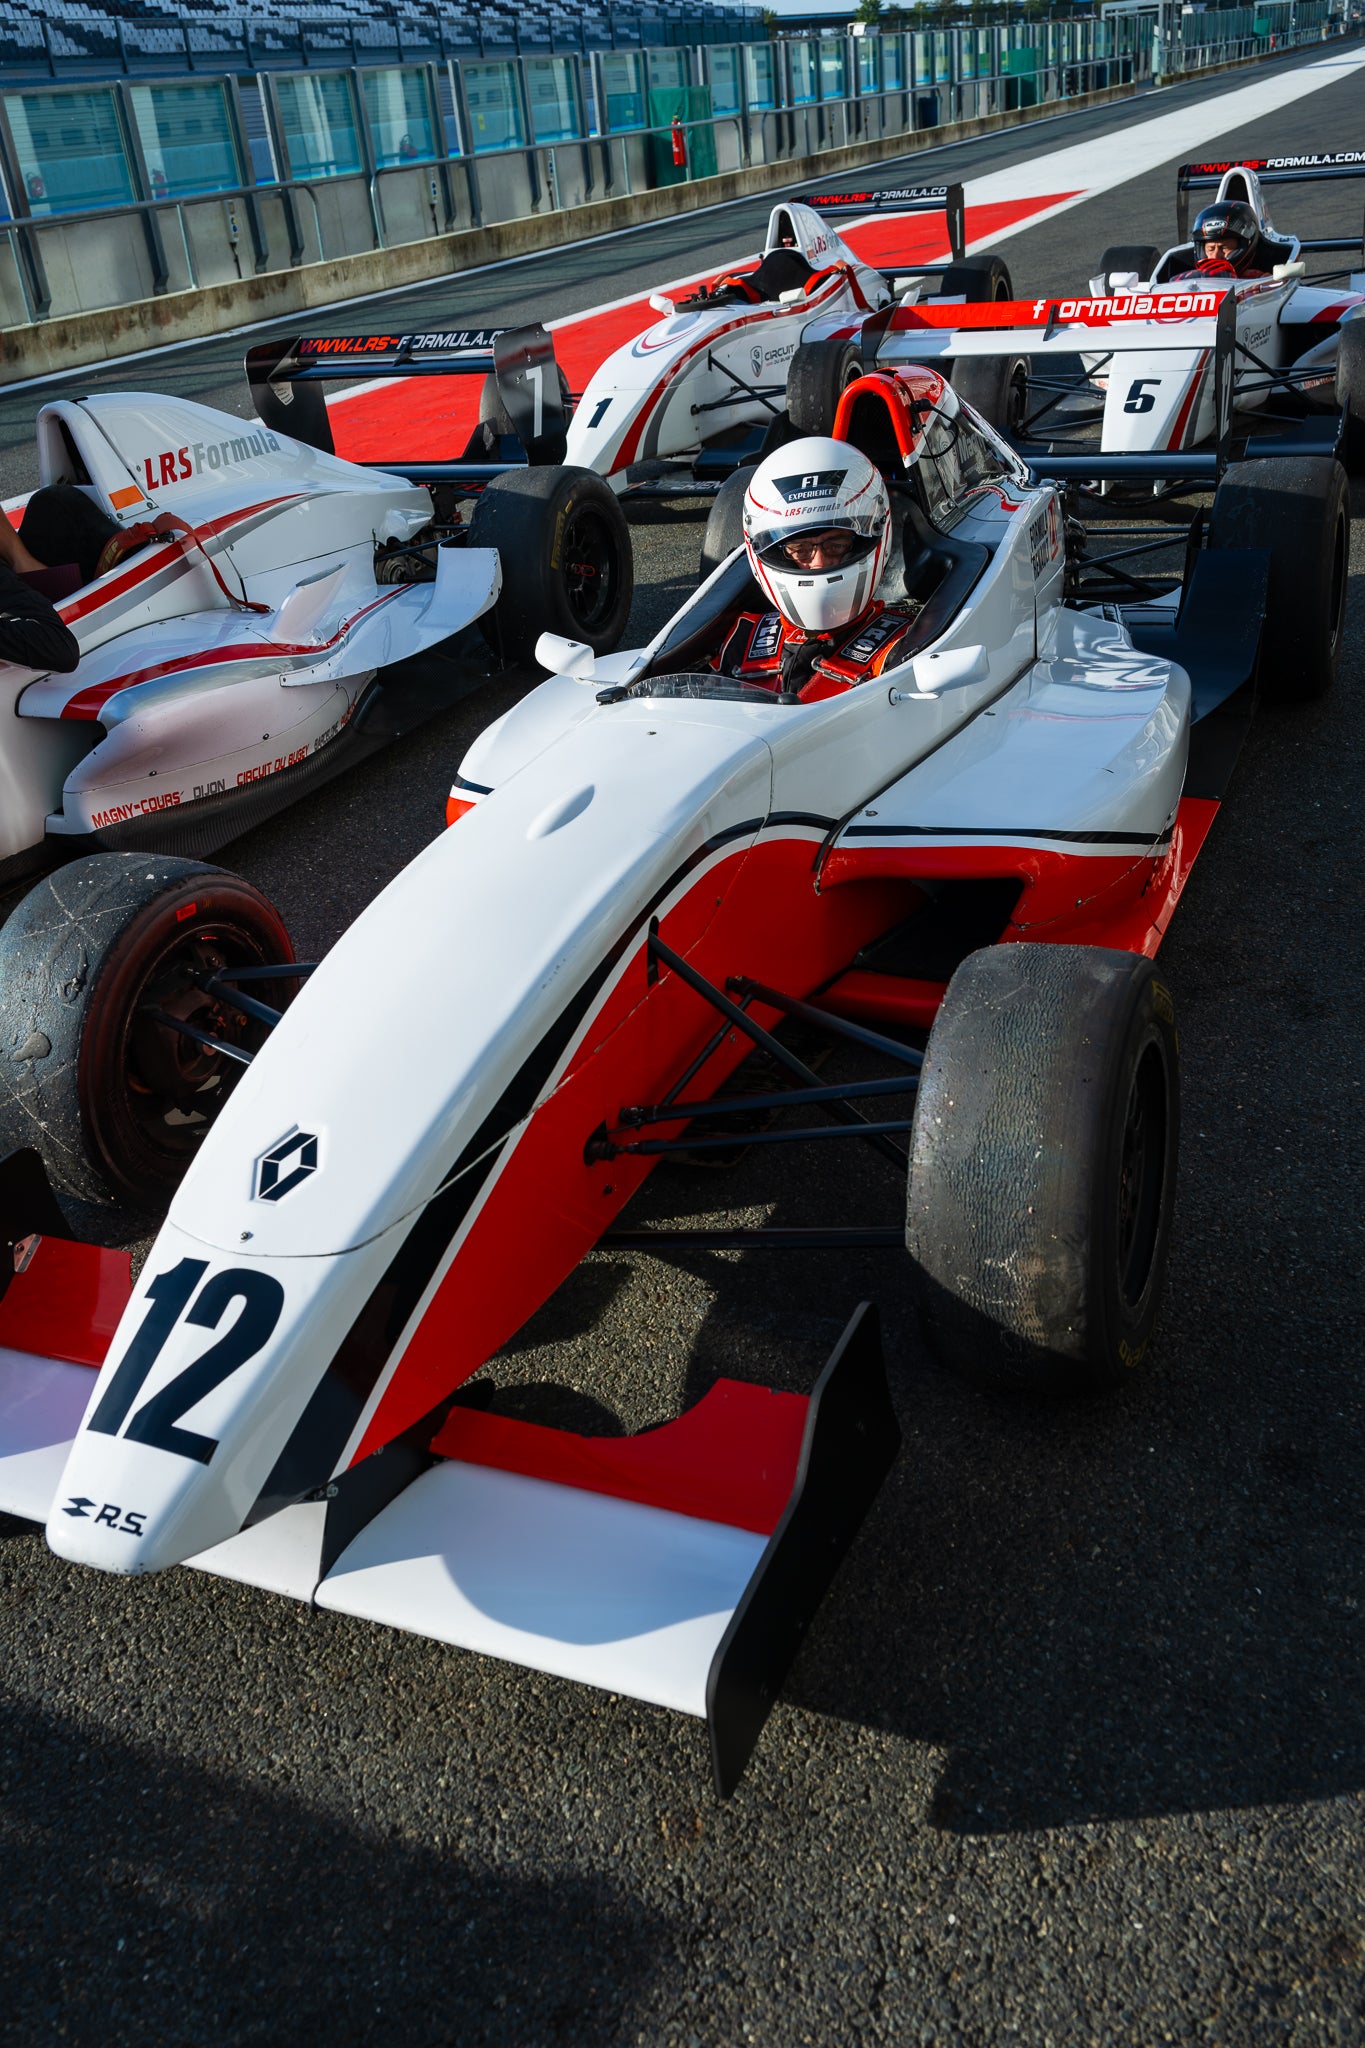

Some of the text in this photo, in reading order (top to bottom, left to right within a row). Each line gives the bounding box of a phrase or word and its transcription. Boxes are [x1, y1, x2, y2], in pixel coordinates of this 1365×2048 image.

[764, 343, 795, 361] CIRCUIT
[1123, 378, 1162, 414] 5
[586, 397, 614, 428] 1
[143, 429, 281, 491] LRSFormula
[788, 488, 834, 501] EXPERIENCE
[801, 475, 819, 489] F1
[784, 502, 841, 517] LRSFormula
[755, 616, 781, 648] TRS
[853, 618, 900, 652] TRS
[91, 791, 181, 829] MAGNY-COURS
[193, 778, 226, 800] DIJON
[236, 761, 272, 787] CIRCUIT
[86, 1257, 285, 1467] 12
